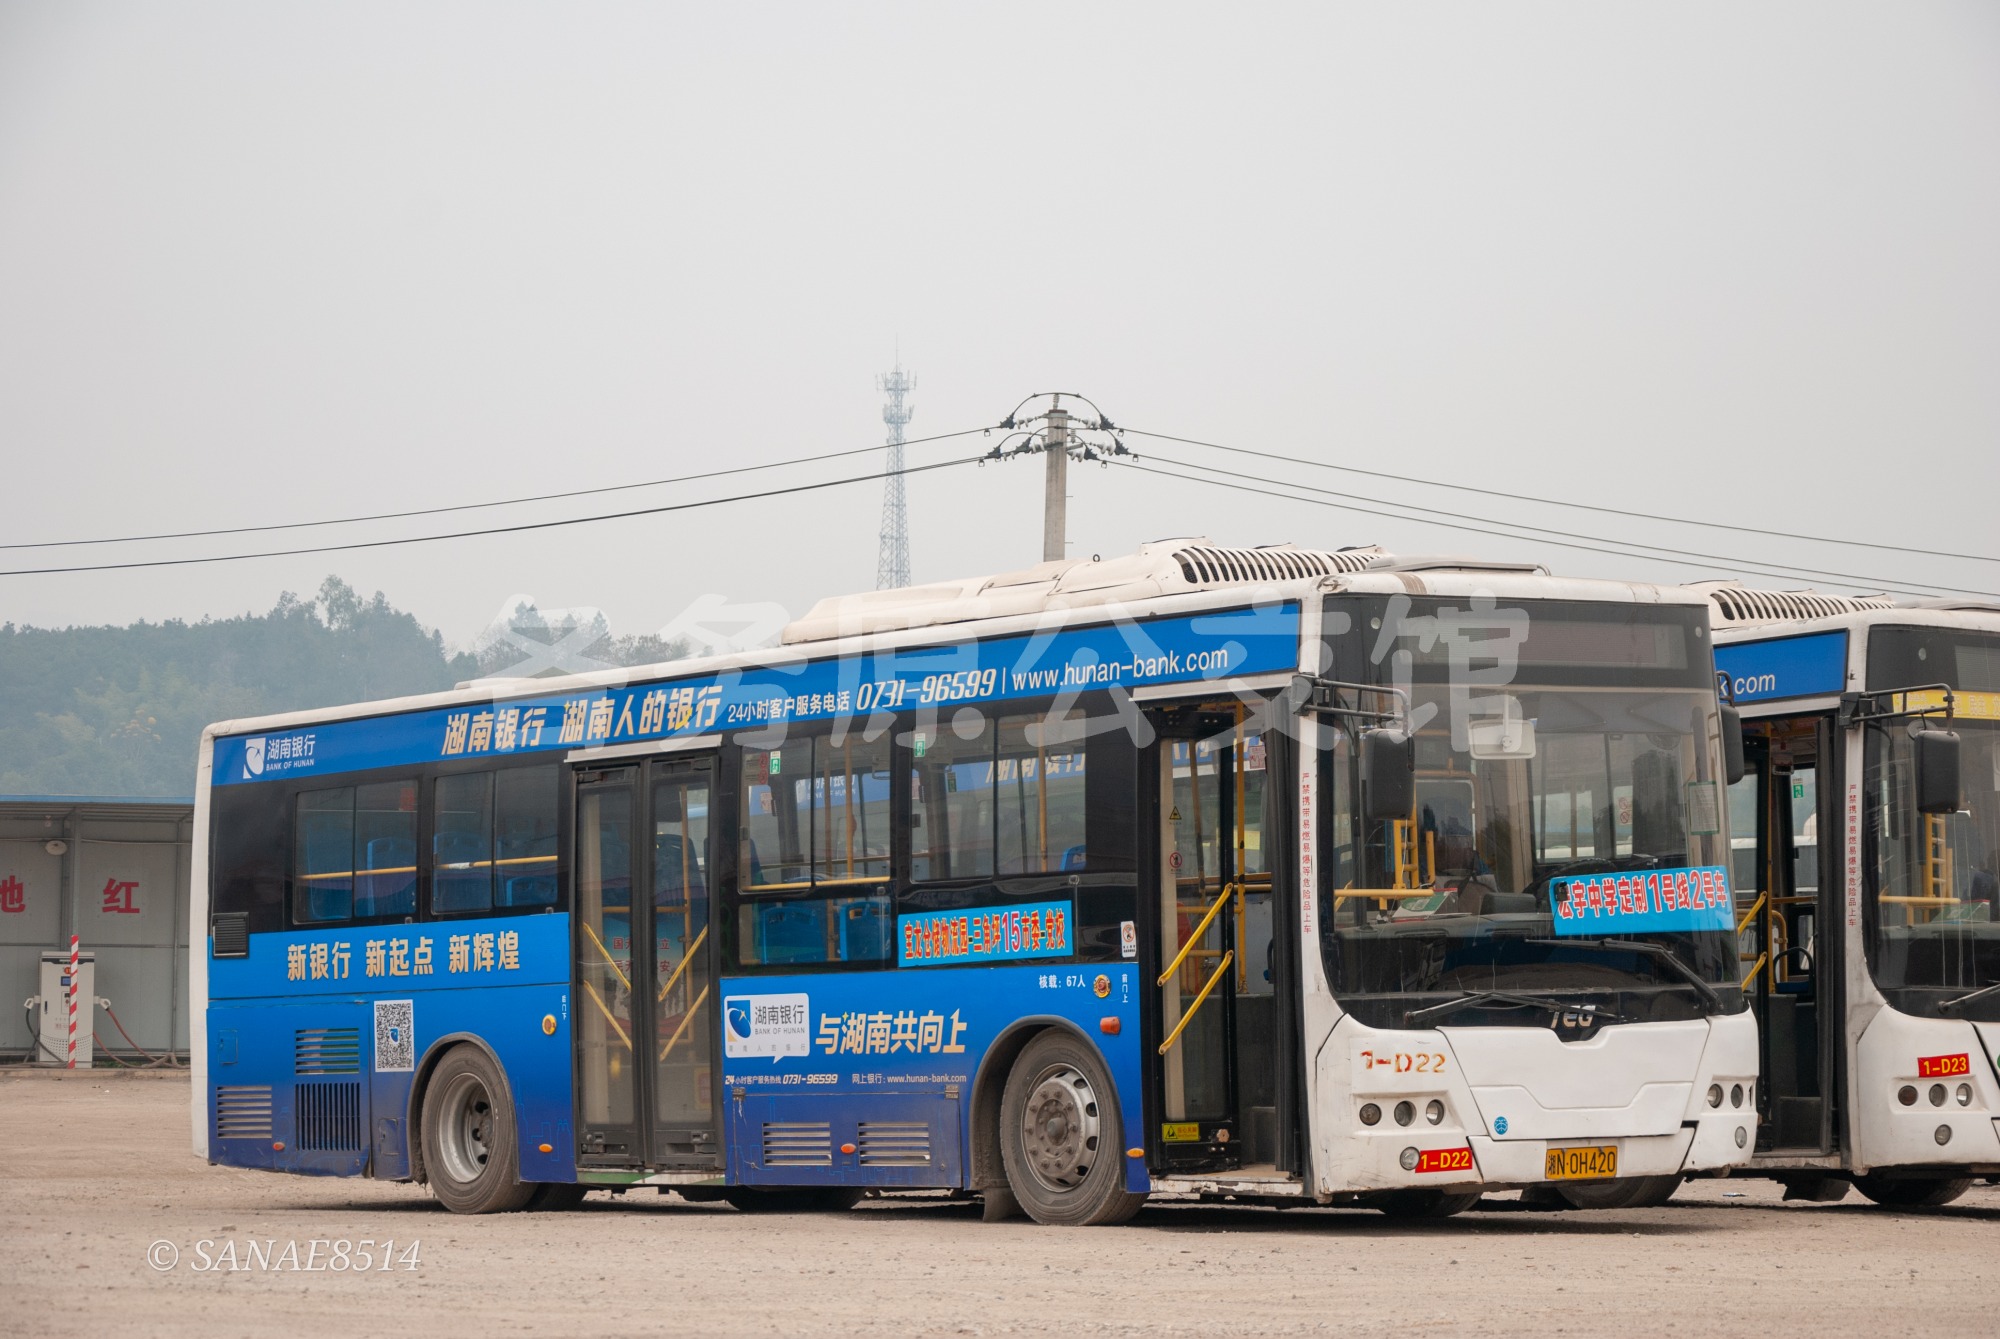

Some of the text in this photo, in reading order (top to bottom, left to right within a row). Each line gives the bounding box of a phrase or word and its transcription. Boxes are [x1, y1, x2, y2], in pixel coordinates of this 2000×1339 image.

[441, 648, 1229, 757] 湖南银行 湖南人的银行 24小时客户服务电话 0731-96599 www.hunan-bank.com
[267, 734, 316, 761] 湖南银行
[266, 758, 315, 772] BANK OF HUNAN
[1302, 772, 1312, 934] 严禁携带易燃易爆等危险品上车
[102, 878, 141, 914] 红
[287, 931, 520, 981] 新银行 新起点 新辉煌
[1121, 973, 1129, 1003] 前门上
[754, 1004, 805, 1026] 湖南银行
[754, 1028, 771, 1036] BANK
[783, 1026, 806, 1035] HUNAN
[815, 1008, 968, 1055] 与湖南共向上
[1360, 1050, 1446, 1074] 1-D22
[1923, 1056, 1968, 1075] 1-D23
[782, 1073, 838, 1085] 0731-96599
[887, 1073, 967, 1084] www.hunan-bank.com
[1420, 1151, 1470, 1170] 1-D22
